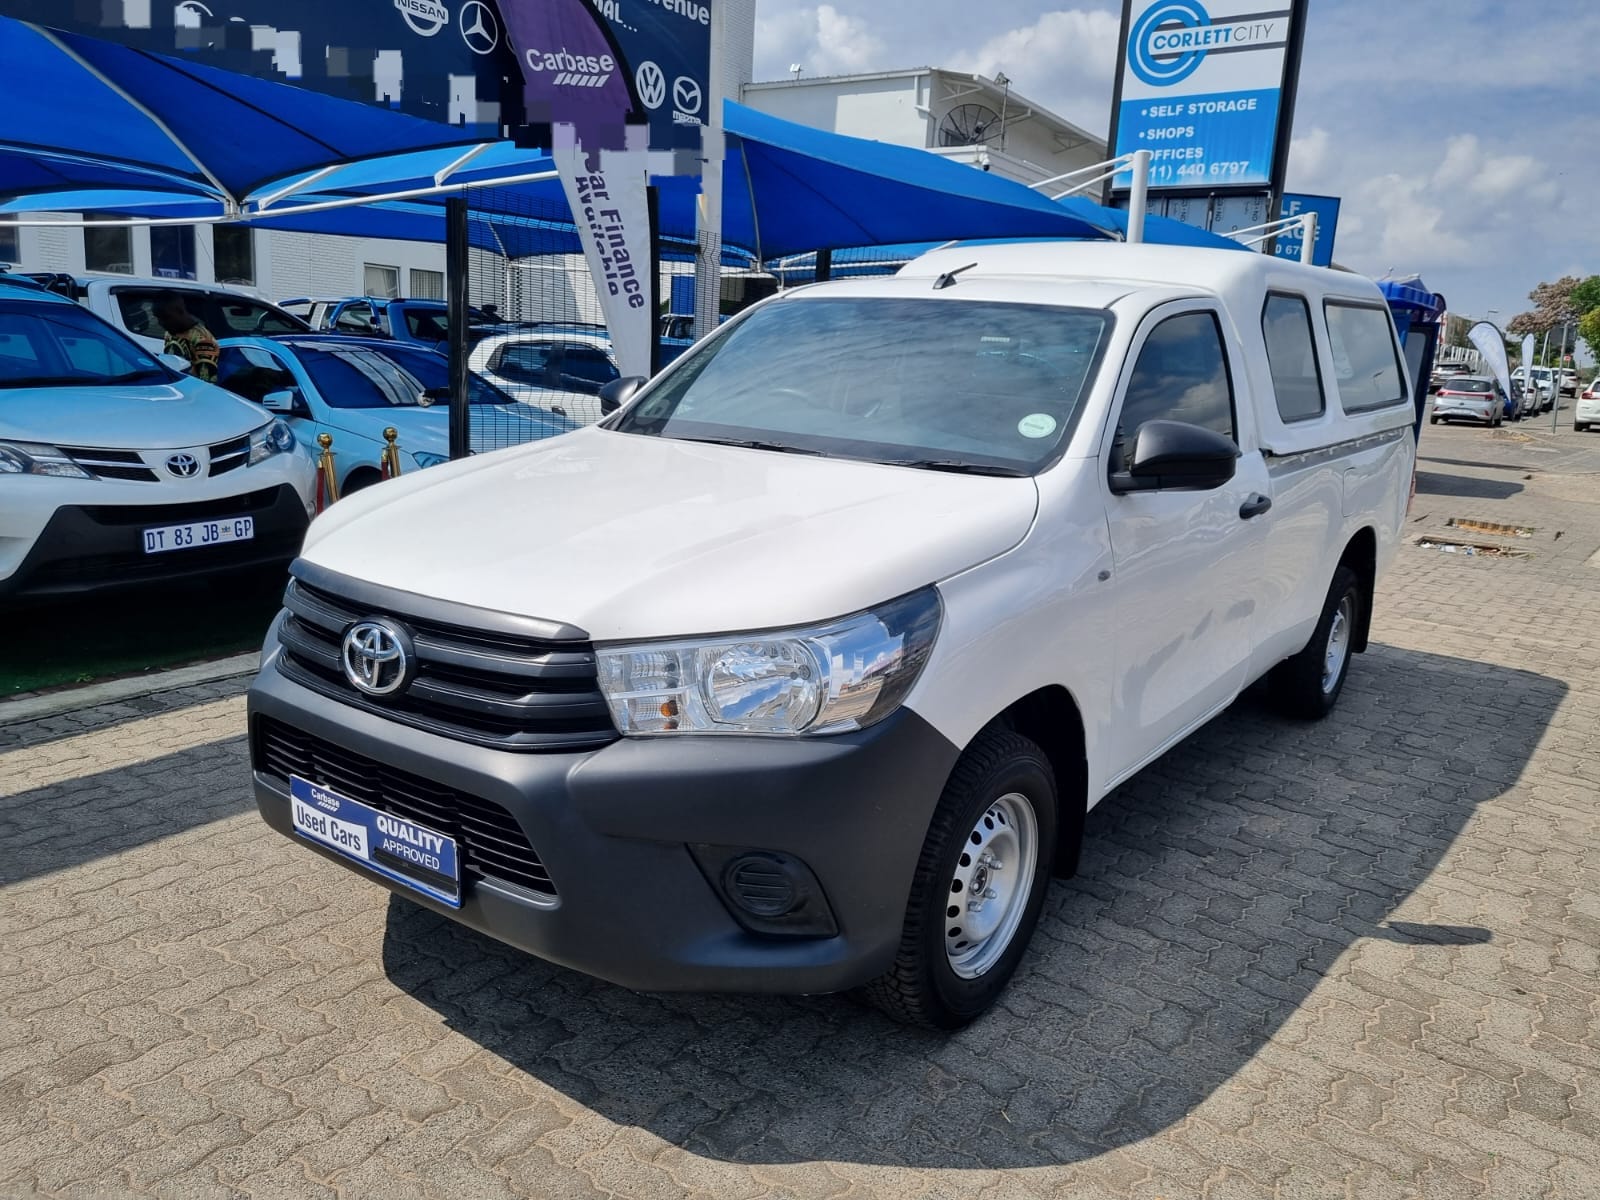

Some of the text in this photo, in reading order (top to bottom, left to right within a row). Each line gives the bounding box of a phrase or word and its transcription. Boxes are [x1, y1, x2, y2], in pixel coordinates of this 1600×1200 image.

[397, 0, 446, 20] NISSAN
[648, 0, 710, 25] enue
[526, 47, 615, 74] Carbase
[1149, 98, 1257, 117] SELF STORAGE
[1147, 126, 1195, 140] SHOPS
[1177, 162, 1206, 176] 440
[1209, 160, 1250, 176] 6797
[600, 209, 645, 309] Finance
[146, 519, 252, 550] DT 83 JB GP
[311, 788, 340, 809] Carbase
[296, 805, 361, 851] Used Cars
[376, 815, 444, 854] QUALITY
[383, 838, 440, 870] APPROVED
